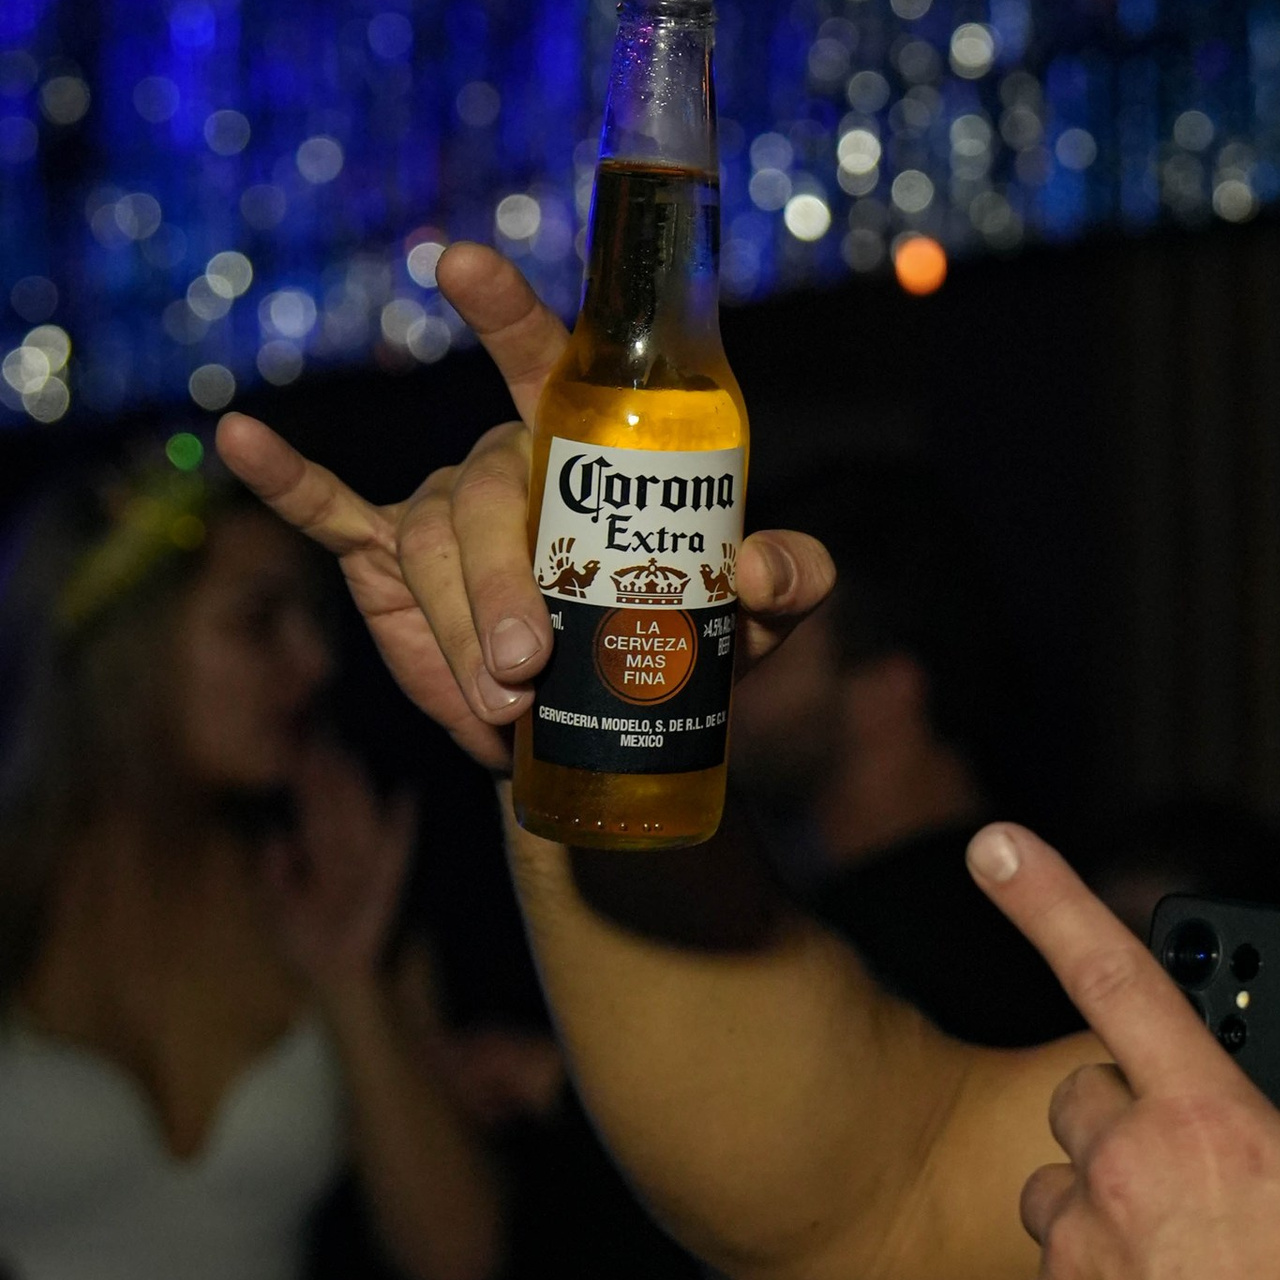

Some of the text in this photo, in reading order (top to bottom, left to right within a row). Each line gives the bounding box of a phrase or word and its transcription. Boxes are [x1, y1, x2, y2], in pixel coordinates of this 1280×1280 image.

[558, 454, 735, 523] Corona
[604, 514, 705, 554] Extra
[636, 621, 661, 635] LA
[604, 635, 688, 651] CERVEZA
[626, 654, 666, 668] MAS
[623, 671, 666, 685] FINA
[539, 705, 599, 729] CERVECERIA
[601, 717, 653, 734] MODELO,
[655, 720, 667, 733] S.
[669, 719, 683, 732] DE
[685, 717, 704, 731] R.L.
[705, 713, 717, 728] DE
[620, 734, 664, 748] MEXICO
